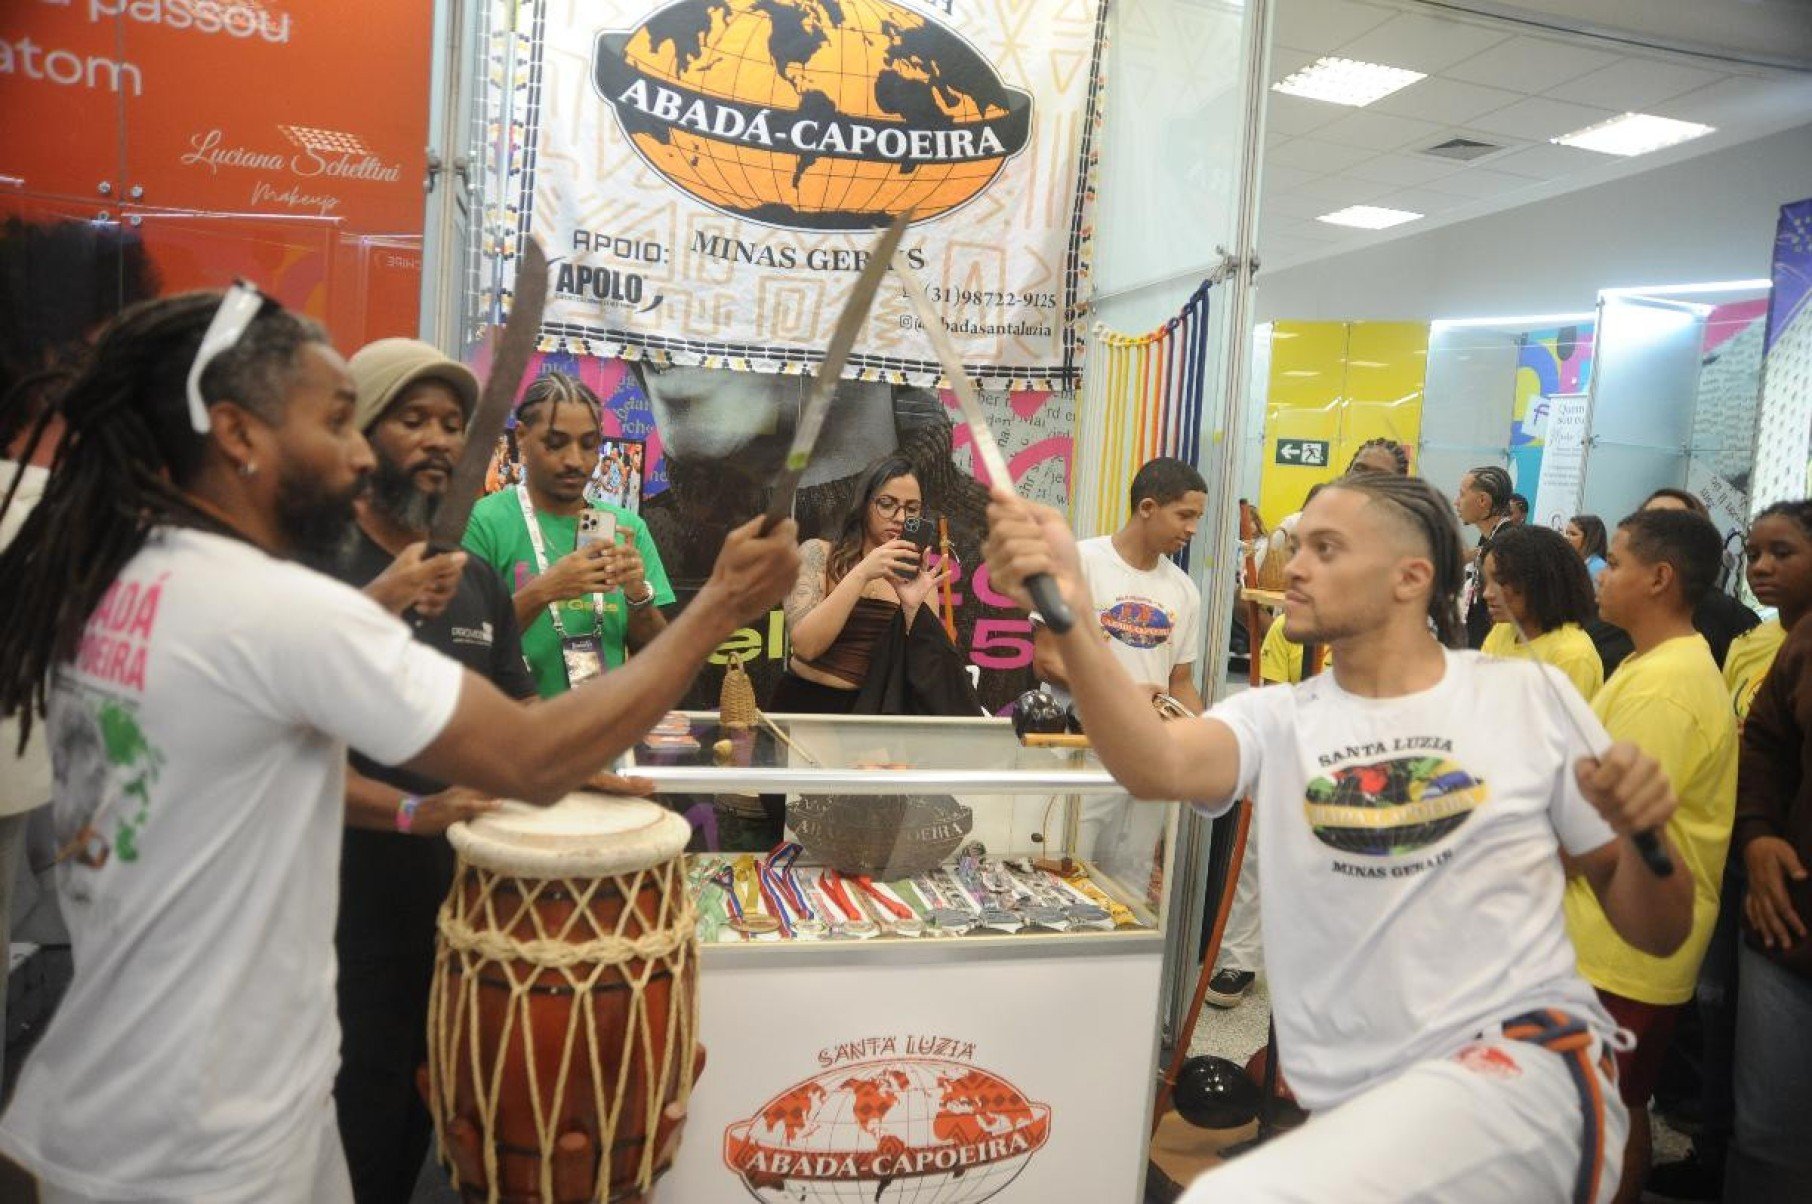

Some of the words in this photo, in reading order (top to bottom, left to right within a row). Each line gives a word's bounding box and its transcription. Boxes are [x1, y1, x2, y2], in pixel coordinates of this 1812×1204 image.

[617, 78, 1008, 160] ABADÁ-CAPOEIRA
[180, 129, 285, 175] Luciana
[573, 229, 669, 264] APOIO:
[690, 230, 797, 270] MINAS
[806, 247, 926, 272] GERS
[555, 263, 644, 304] APOLO
[1318, 742, 1387, 768] SANTA
[1394, 737, 1454, 753] LUZIA
[1332, 860, 1387, 879] MINAS
[817, 1037, 897, 1068] SANTA
[905, 1034, 977, 1061] LUZIA
[746, 1135, 1029, 1178] ABADÁ-CAPOEIRA
